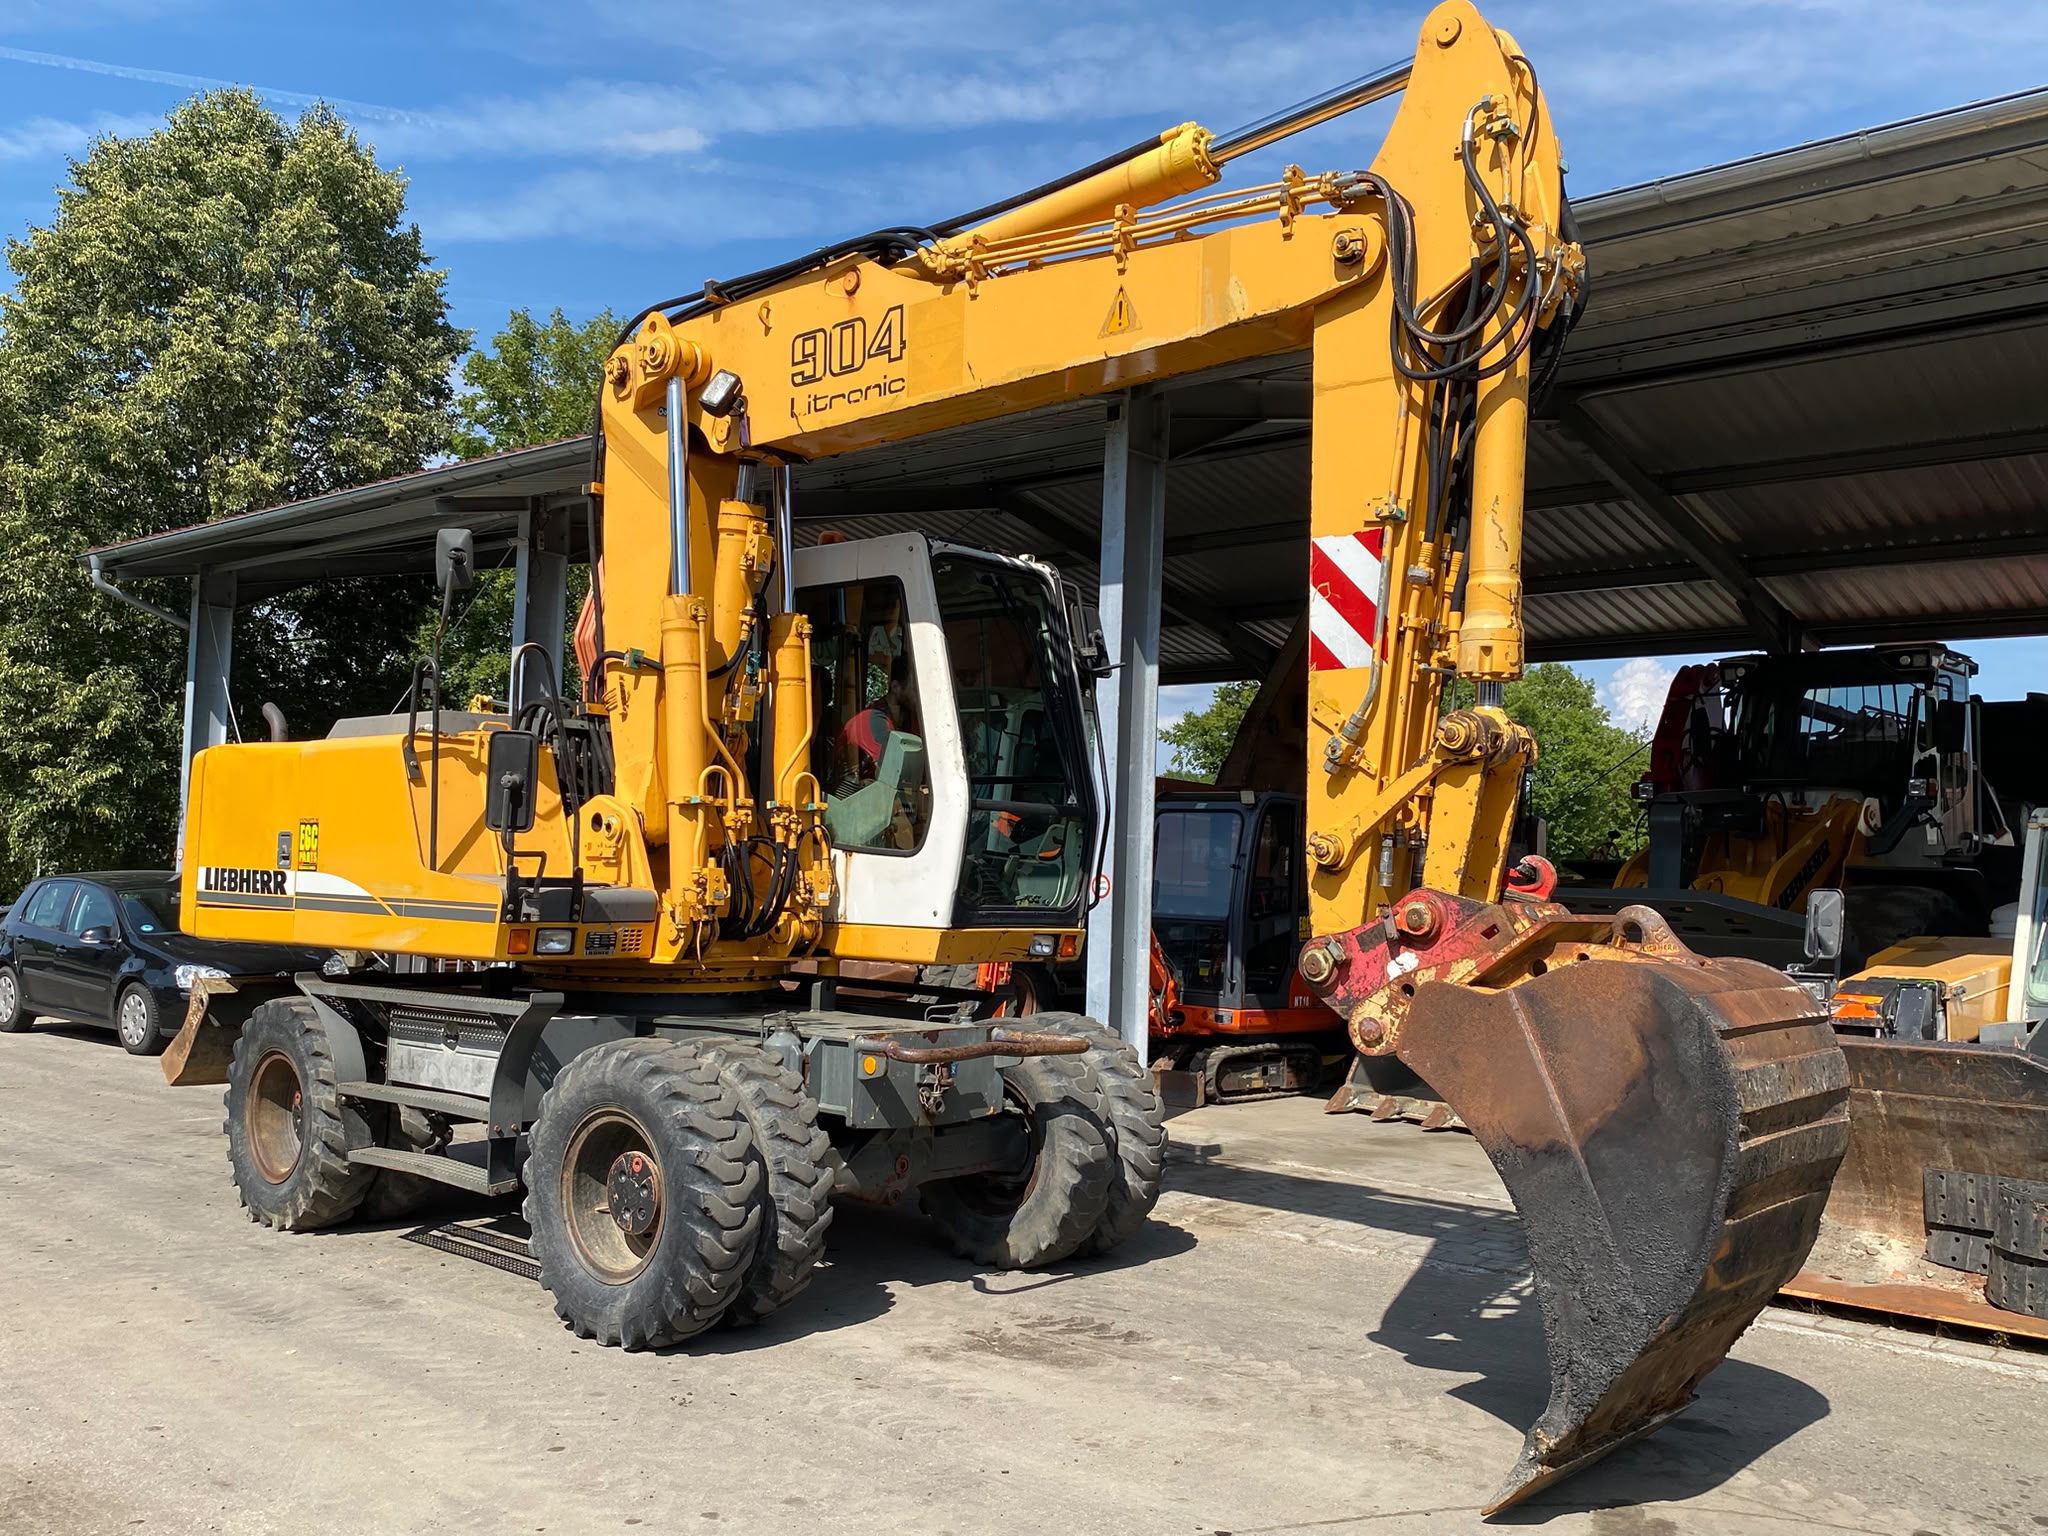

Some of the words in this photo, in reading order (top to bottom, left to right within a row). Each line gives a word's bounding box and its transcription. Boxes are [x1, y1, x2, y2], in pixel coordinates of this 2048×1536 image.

[791, 304, 906, 387] 904
[790, 375, 905, 418] Litronic
[299, 851, 317, 863] PARTS
[205, 867, 287, 895] LIEBHERR
